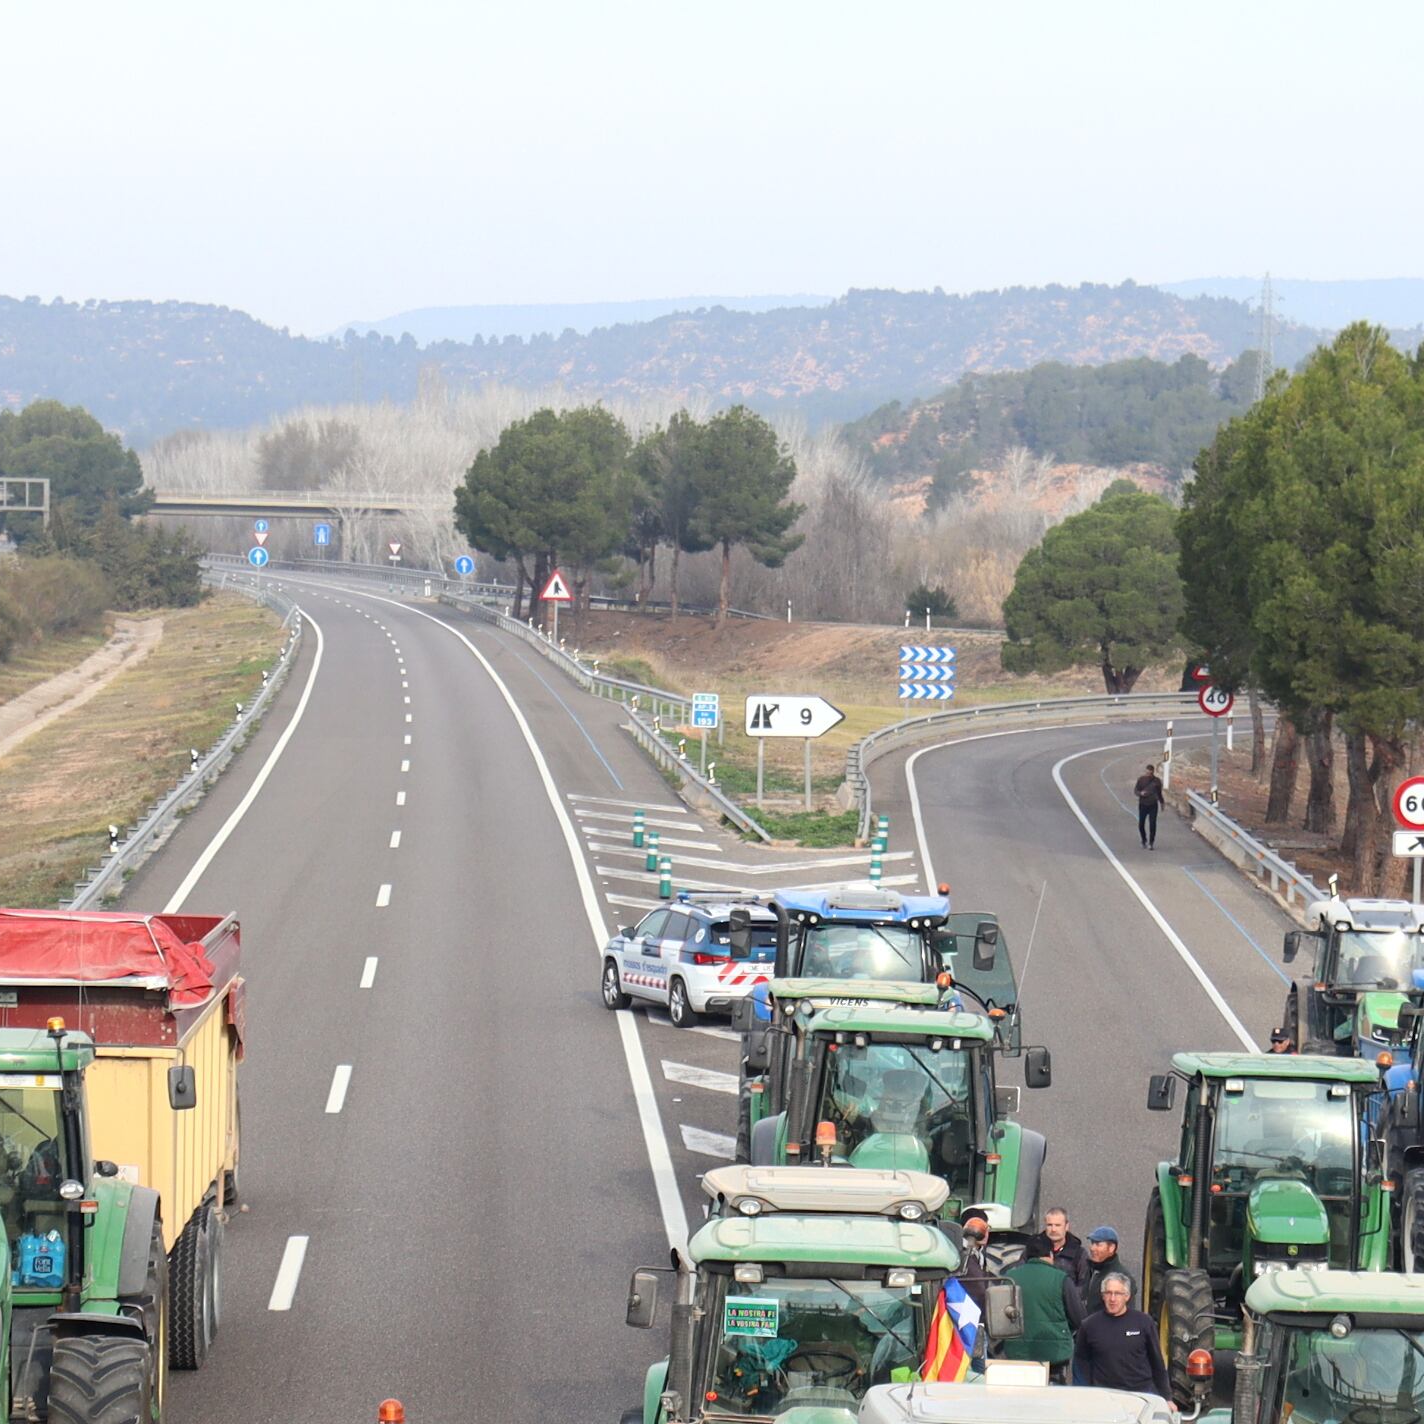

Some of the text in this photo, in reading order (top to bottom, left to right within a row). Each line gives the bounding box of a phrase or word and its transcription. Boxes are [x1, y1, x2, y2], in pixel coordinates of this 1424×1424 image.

[1206, 691, 1227, 704] 40
[697, 718, 713, 726] 193
[800, 708, 812, 725] 9
[829, 997, 870, 1007] VICENS
